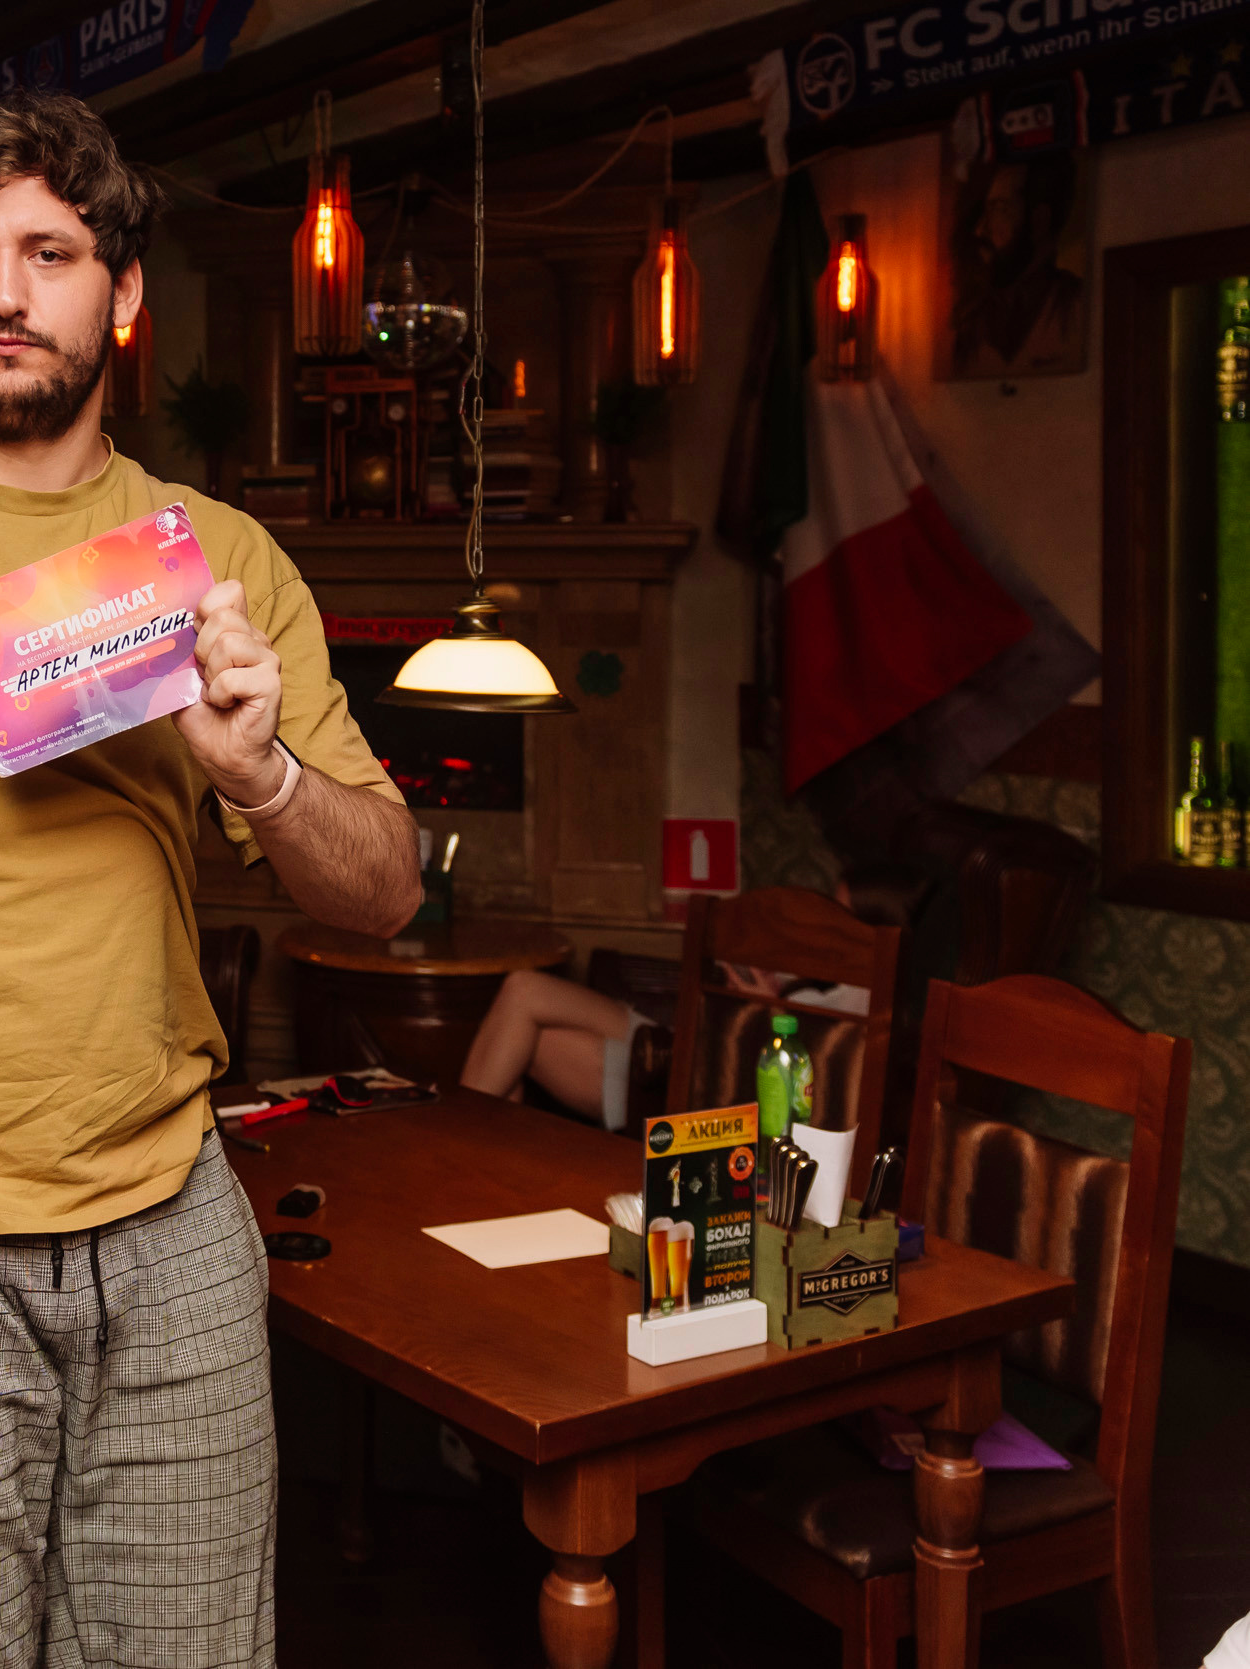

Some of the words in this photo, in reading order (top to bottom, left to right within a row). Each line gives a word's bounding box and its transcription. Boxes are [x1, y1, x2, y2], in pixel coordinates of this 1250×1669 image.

[80, 0, 167, 58] PARIS
[863, 7, 944, 71] FC
[903, 59, 966, 88] Steht
[970, 45, 1015, 73] auf,
[1021, 29, 1092, 60] wenn
[1098, 16, 1136, 41] ihr
[13, 582, 156, 656] СЕРТИФИКАТ
[16, 660, 27, 668] НА
[26, 644, 66, 665] БЕСПЛАТНОЕ
[100, 624, 115, 635] ИГРЕ
[116, 619, 128, 629] ДЛЯ
[133, 603, 166, 621] ЧЕЛОВЕКА
[17, 654, 78, 692] АРТЕМ
[90, 612, 187, 661] МИЛЮТИН
[114, 661, 125, 670] ДЛЯ
[2, 748, 39, 766] Регистрация
[40, 739, 63, 752] команд:
[64, 721, 109, 743] www.kleveria.ru
[36, 724, 75, 743] фотографии:
[687, 1118, 744, 1140] АКЦИЯ
[706, 1222, 751, 1243] БОКАЛ
[704, 1267, 750, 1288] ВТОРОЙ
[704, 1288, 750, 1306] ПОДАРОК
